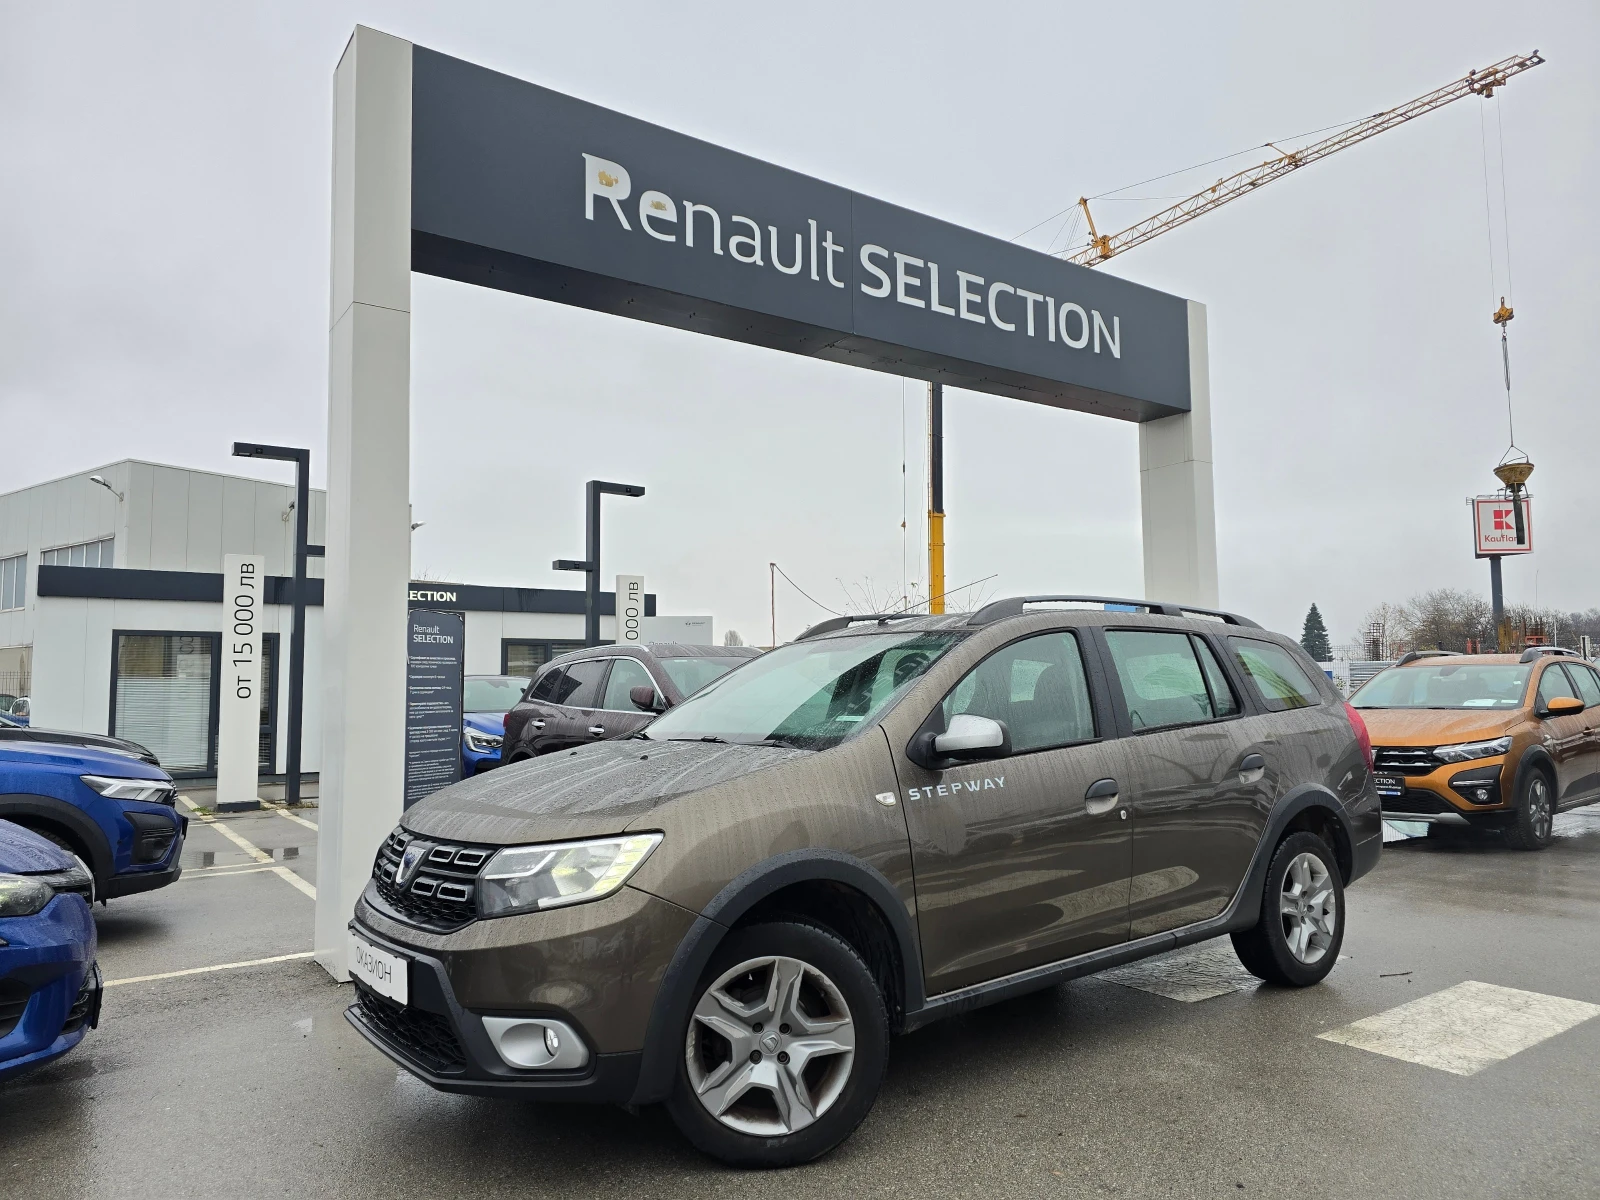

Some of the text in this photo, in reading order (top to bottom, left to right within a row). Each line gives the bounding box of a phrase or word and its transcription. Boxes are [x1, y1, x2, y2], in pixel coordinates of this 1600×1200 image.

[581, 152, 1121, 359] Renault SELECTION
[1484, 534, 1518, 542] Kauflan
[408, 590, 457, 602] ECTION
[625, 581, 639, 640] 000 лв
[233, 563, 255, 699] от 15 000 лв
[413, 624, 440, 634] Renault
[413, 634, 454, 644] SELECTION
[908, 776, 1005, 801] STEPWAY
[356, 946, 392, 984] ОКАЗИОН
